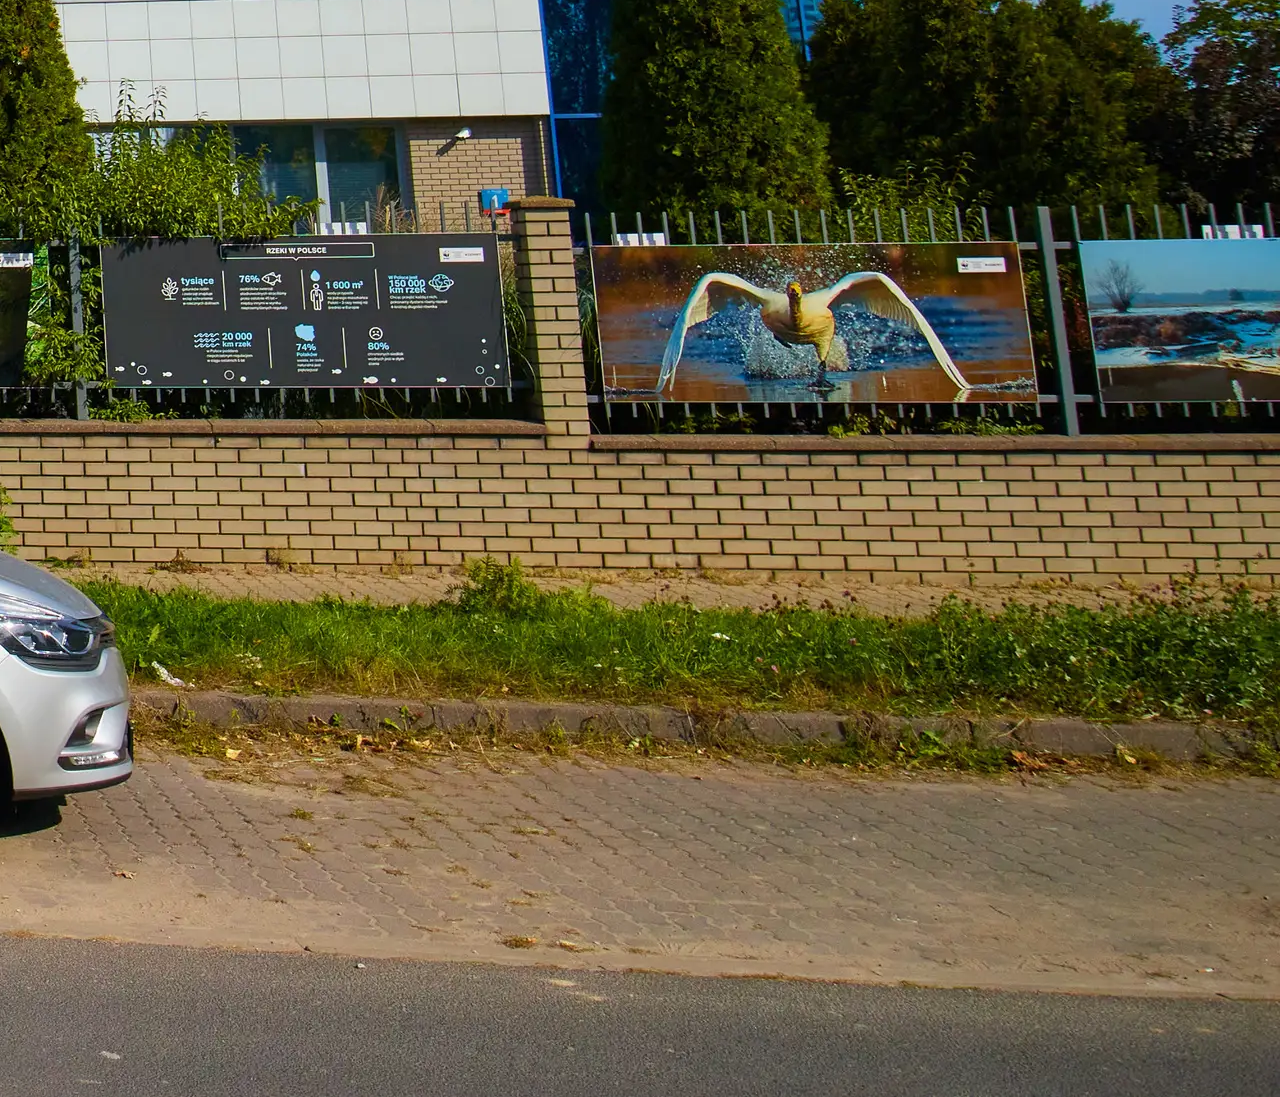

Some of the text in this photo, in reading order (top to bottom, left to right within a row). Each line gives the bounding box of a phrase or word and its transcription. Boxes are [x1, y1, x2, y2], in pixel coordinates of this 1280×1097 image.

[181, 277, 214, 286] tysiące
[239, 275, 260, 283] 76%
[407, 279, 426, 287] 000
[333, 281, 351, 289] 600
[235, 332, 253, 340] 000
[296, 343, 316, 351] 74%
[368, 342, 390, 350] 80%
